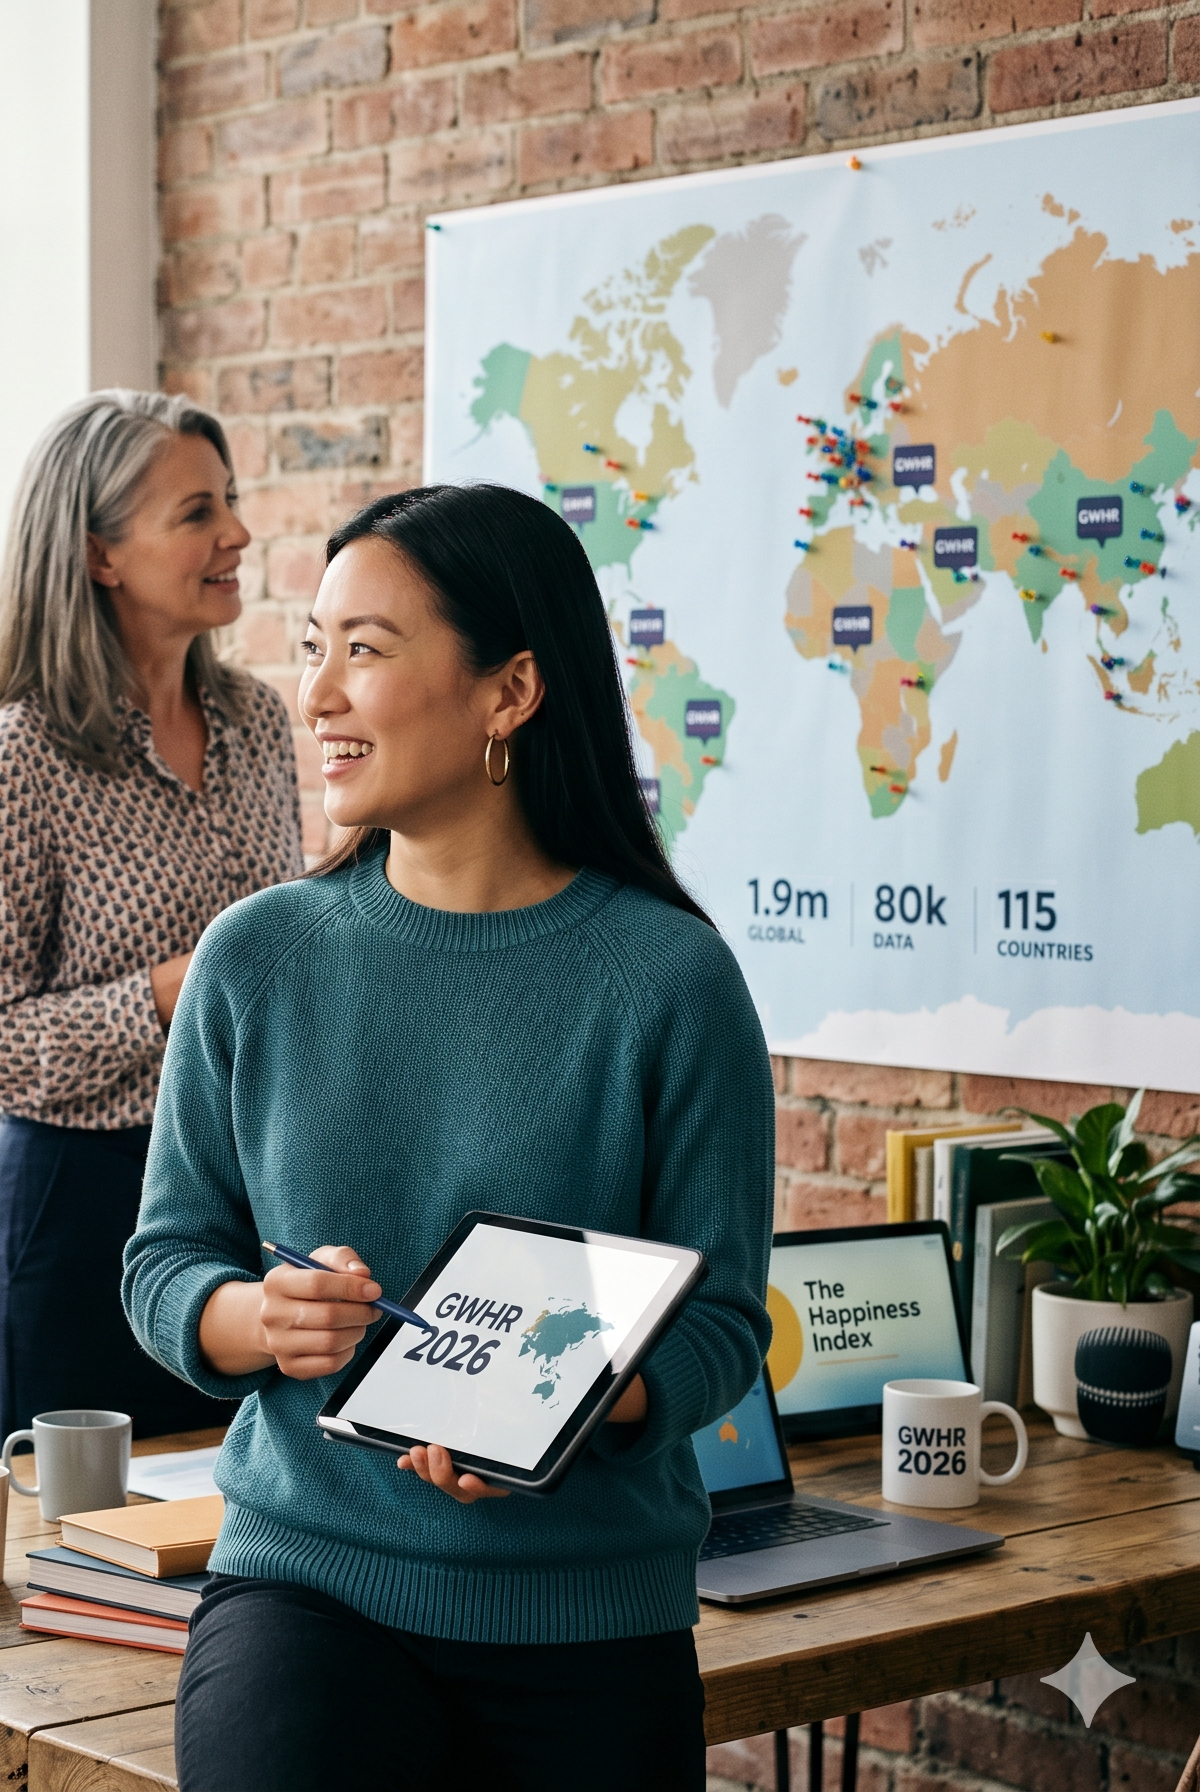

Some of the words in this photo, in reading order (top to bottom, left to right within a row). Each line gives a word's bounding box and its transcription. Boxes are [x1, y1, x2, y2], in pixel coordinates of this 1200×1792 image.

[894, 455, 934, 473] GWHR
[1077, 507, 1120, 525] GWHR
[935, 538, 975, 554] GWHR
[748, 877, 829, 919] 1.9m
[874, 884, 948, 926] 80k
[998, 889, 1058, 932] 115
[747, 924, 806, 944] GLOBAL
[873, 932, 915, 951] DATA
[997, 939, 1094, 962] COUNTRIES
[803, 1279, 845, 1301] The
[435, 1292, 524, 1333] GWHR
[808, 1300, 921, 1328] Happiness
[402, 1325, 502, 1376] 2026
[812, 1329, 873, 1353] Index
[898, 1425, 967, 1448] GWHR
[898, 1448, 967, 1476] 2026
